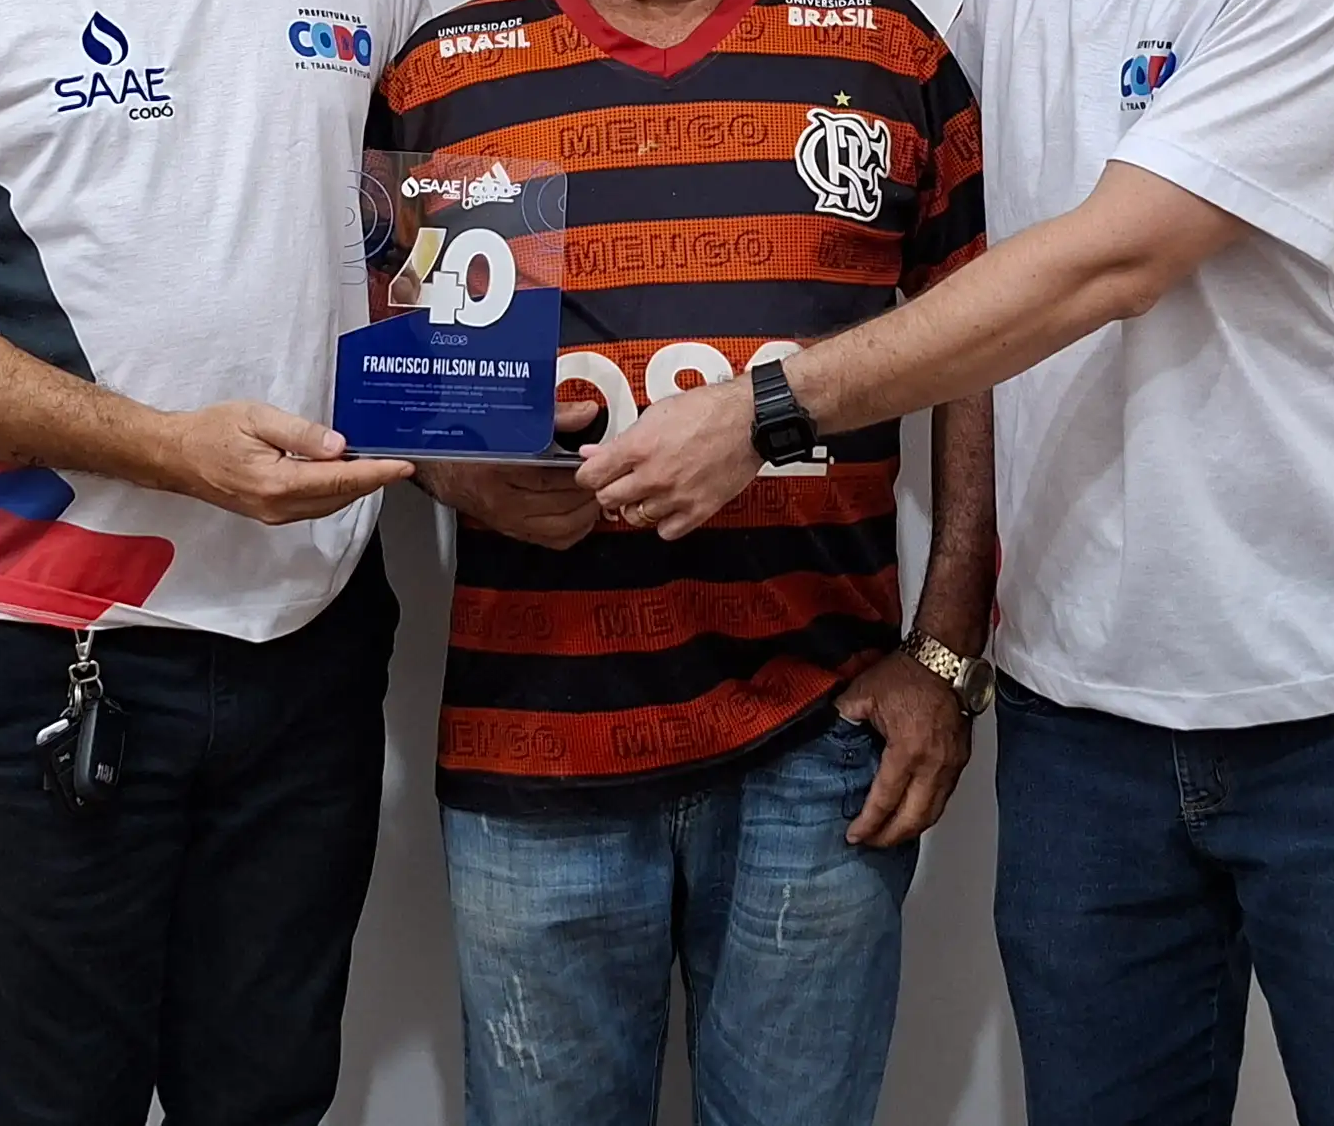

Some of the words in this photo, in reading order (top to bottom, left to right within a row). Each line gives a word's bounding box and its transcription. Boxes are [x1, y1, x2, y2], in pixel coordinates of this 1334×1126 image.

[297, 8, 351, 22] PREFEITURA
[787, 6, 878, 30] BRASIL
[437, 16, 523, 39] UNIVERSIDADE
[438, 28, 531, 59] BRASIL
[54, 67, 172, 113] SAAE
[128, 102, 174, 121] CODÓ
[419, 178, 461, 194] SAAE
[387, 227, 516, 328] 40
[430, 331, 468, 346] Anos
[363, 355, 430, 375] FRANCISCO
[432, 358, 476, 377] HILSON
[479, 360, 495, 378] DA
[497, 360, 530, 379] SILVA
